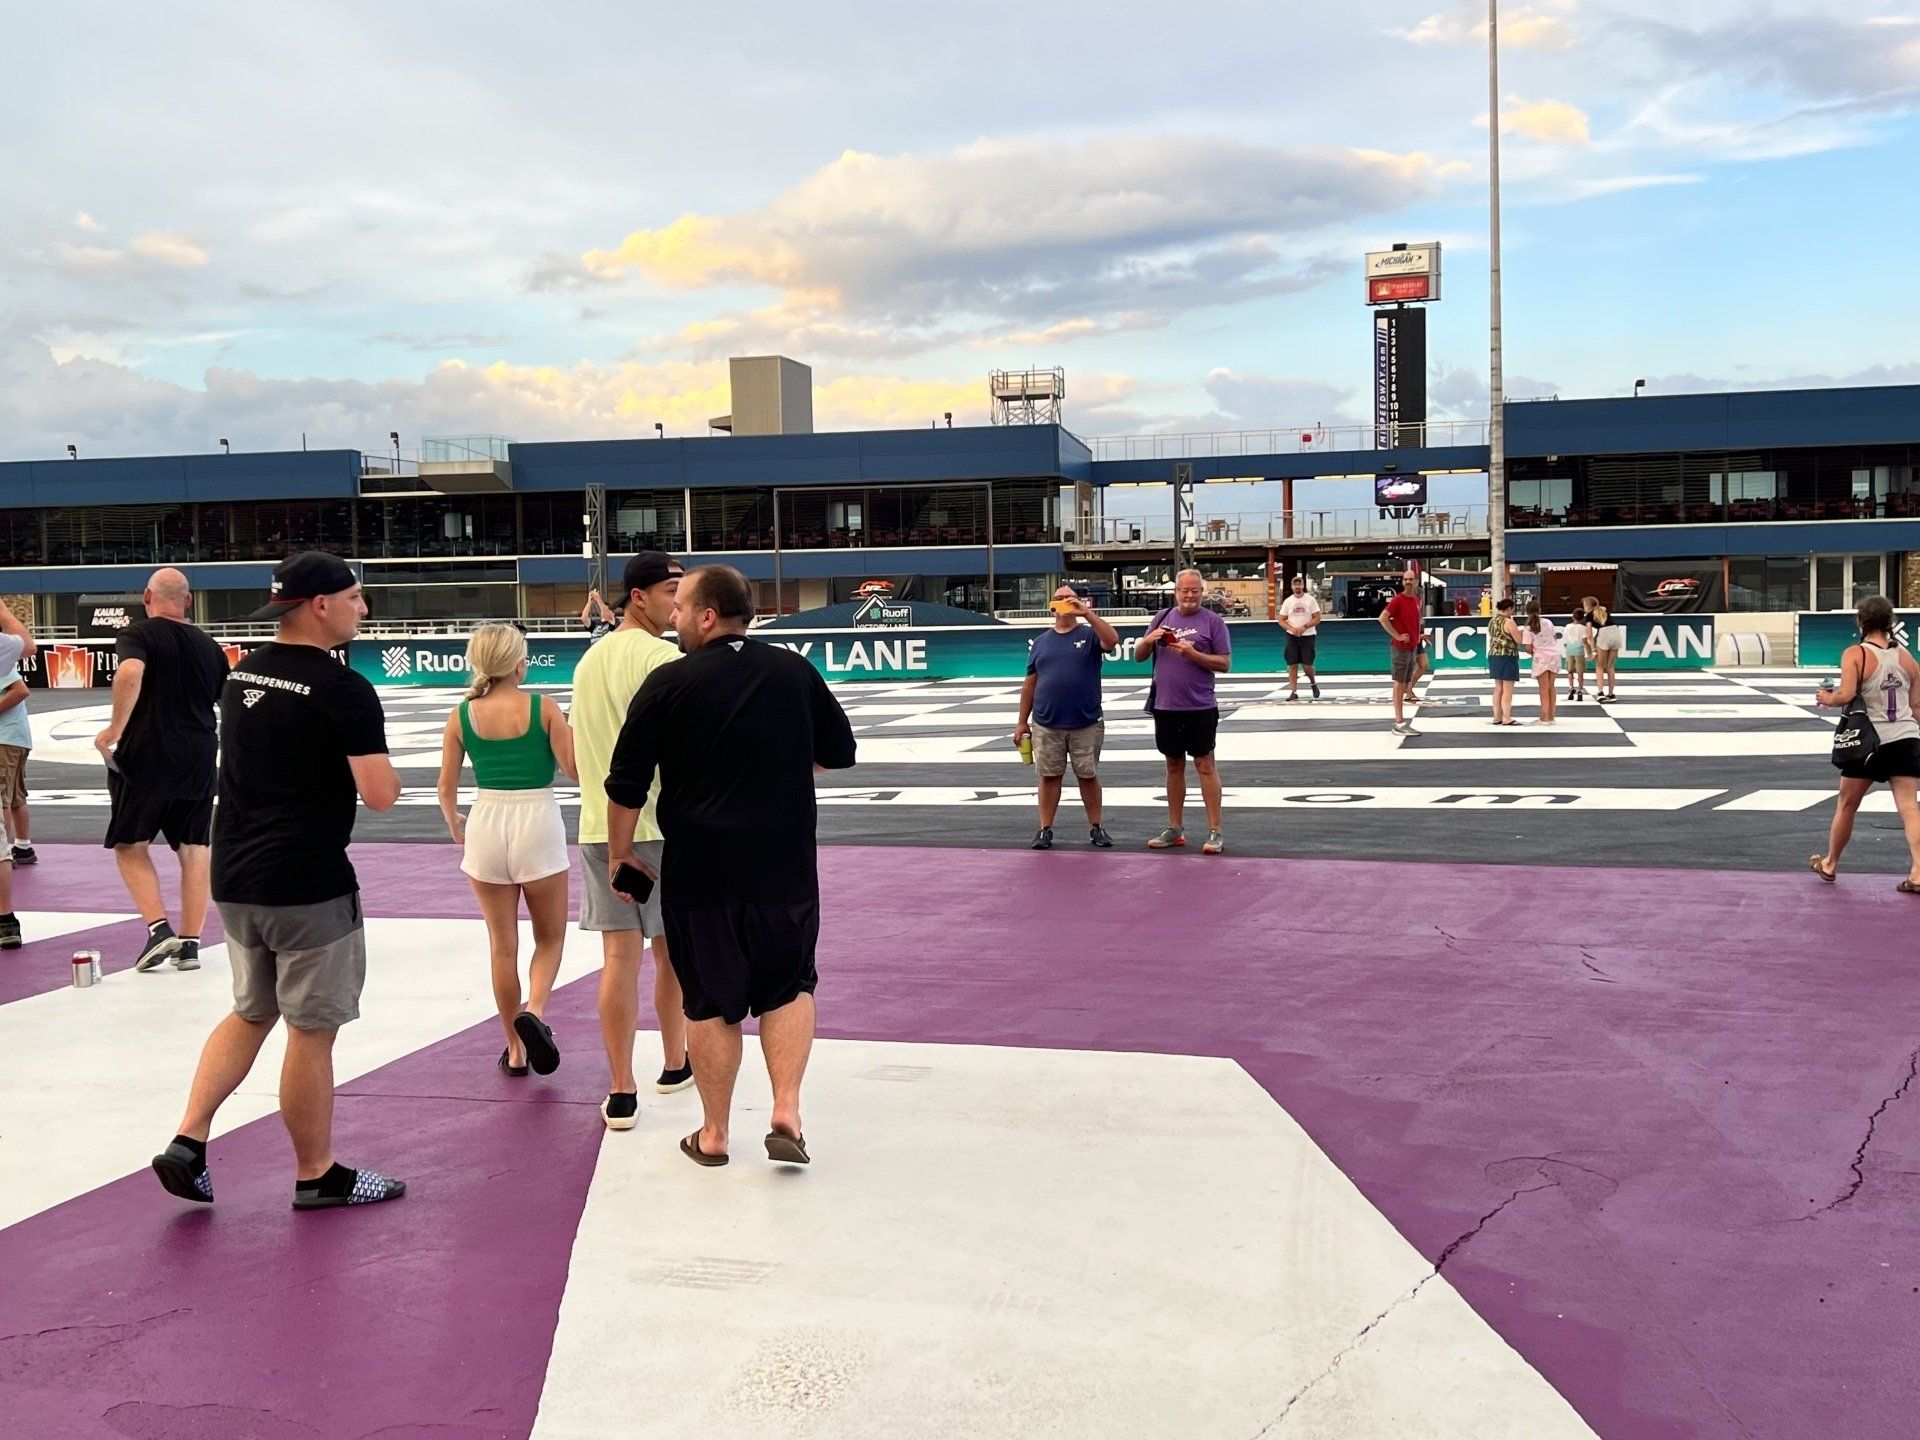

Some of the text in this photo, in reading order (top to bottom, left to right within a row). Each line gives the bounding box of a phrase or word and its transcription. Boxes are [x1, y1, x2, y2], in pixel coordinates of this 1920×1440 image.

[1381, 255, 1413, 266] MICHIGAN
[1391, 328, 1396, 336] 2
[1391, 337, 1396, 345] 3
[1391, 346, 1396, 354] 4
[1391, 356, 1396, 364] 5
[1391, 365, 1396, 373] 6
[1391, 393, 1396, 401] 9
[1390, 402, 1399, 410] 10
[882, 609, 908, 617] Ruoff
[825, 640, 927, 671] LANE
